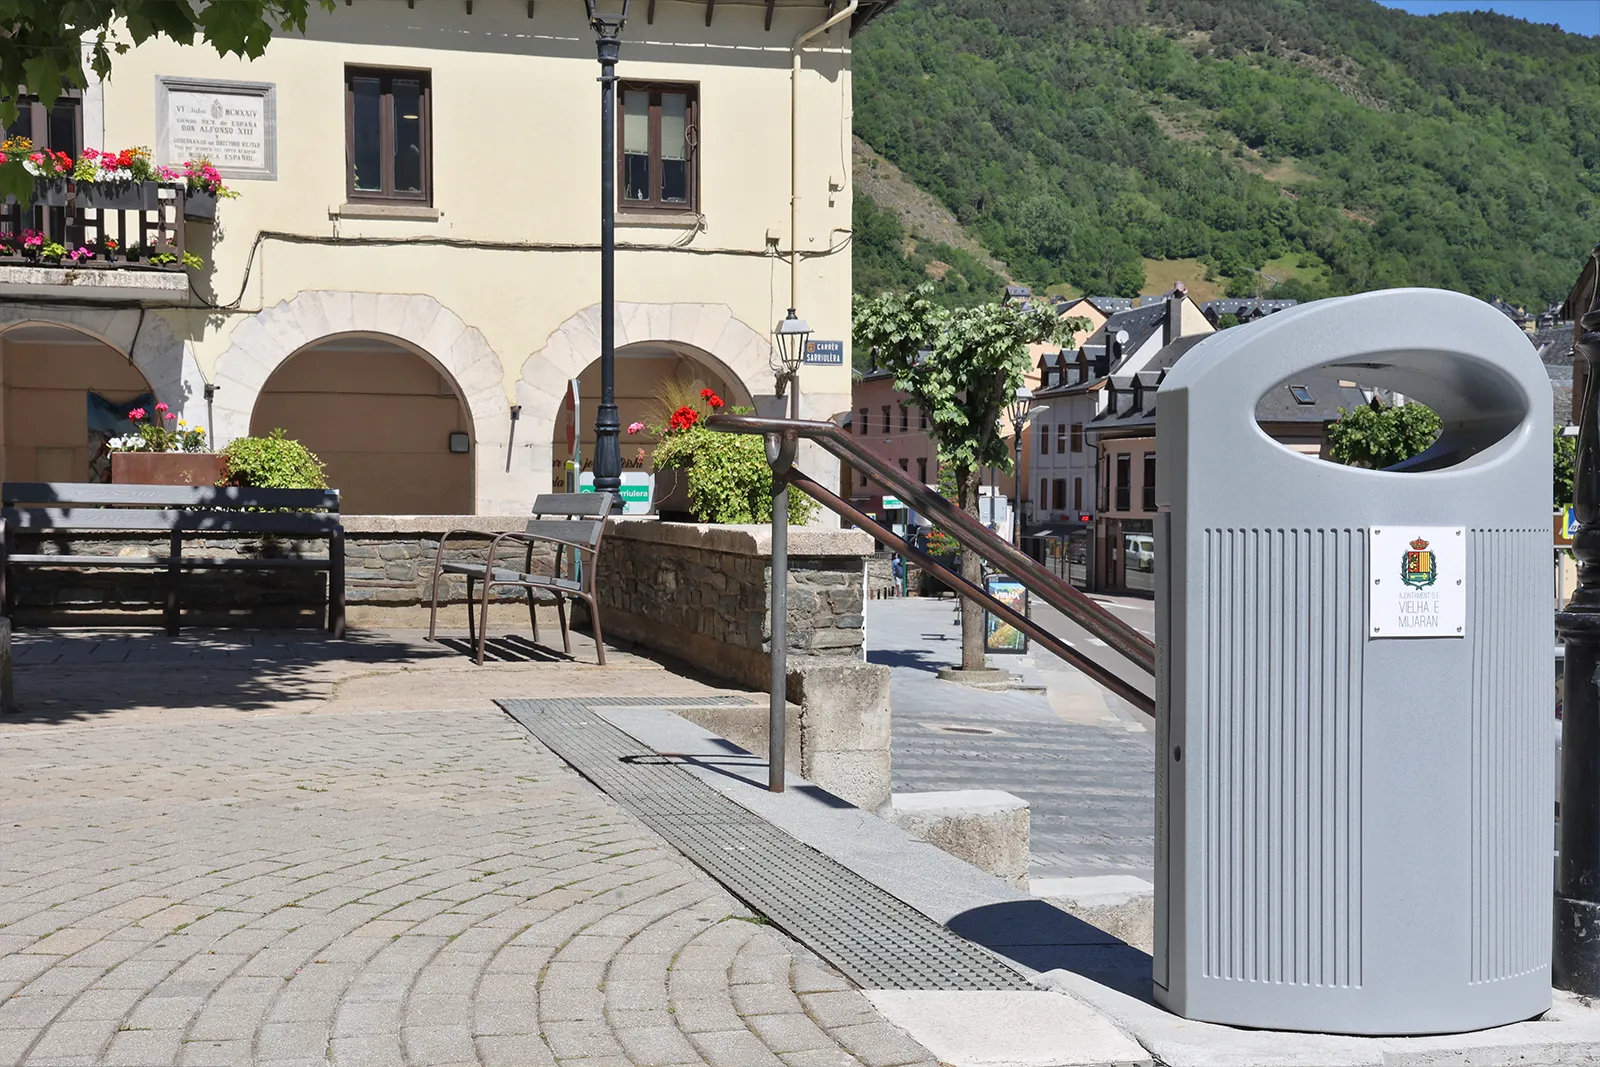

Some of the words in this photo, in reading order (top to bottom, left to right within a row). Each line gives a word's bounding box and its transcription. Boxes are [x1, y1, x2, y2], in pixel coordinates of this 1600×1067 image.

[225, 108, 257, 117] MCMXXIV
[231, 120, 257, 128] ESPAÑA
[200, 126, 234, 135] ALFONSO
[224, 153, 254, 161] ESPAÑOL
[619, 489, 648, 498] rriulera
[1398, 591, 1430, 599] AJUNTAMENT
[1432, 591, 1439, 599] DE
[1398, 600, 1430, 613] VIELHA
[1433, 600, 1439, 613] E
[1398, 615, 1439, 628] MIJARAN
